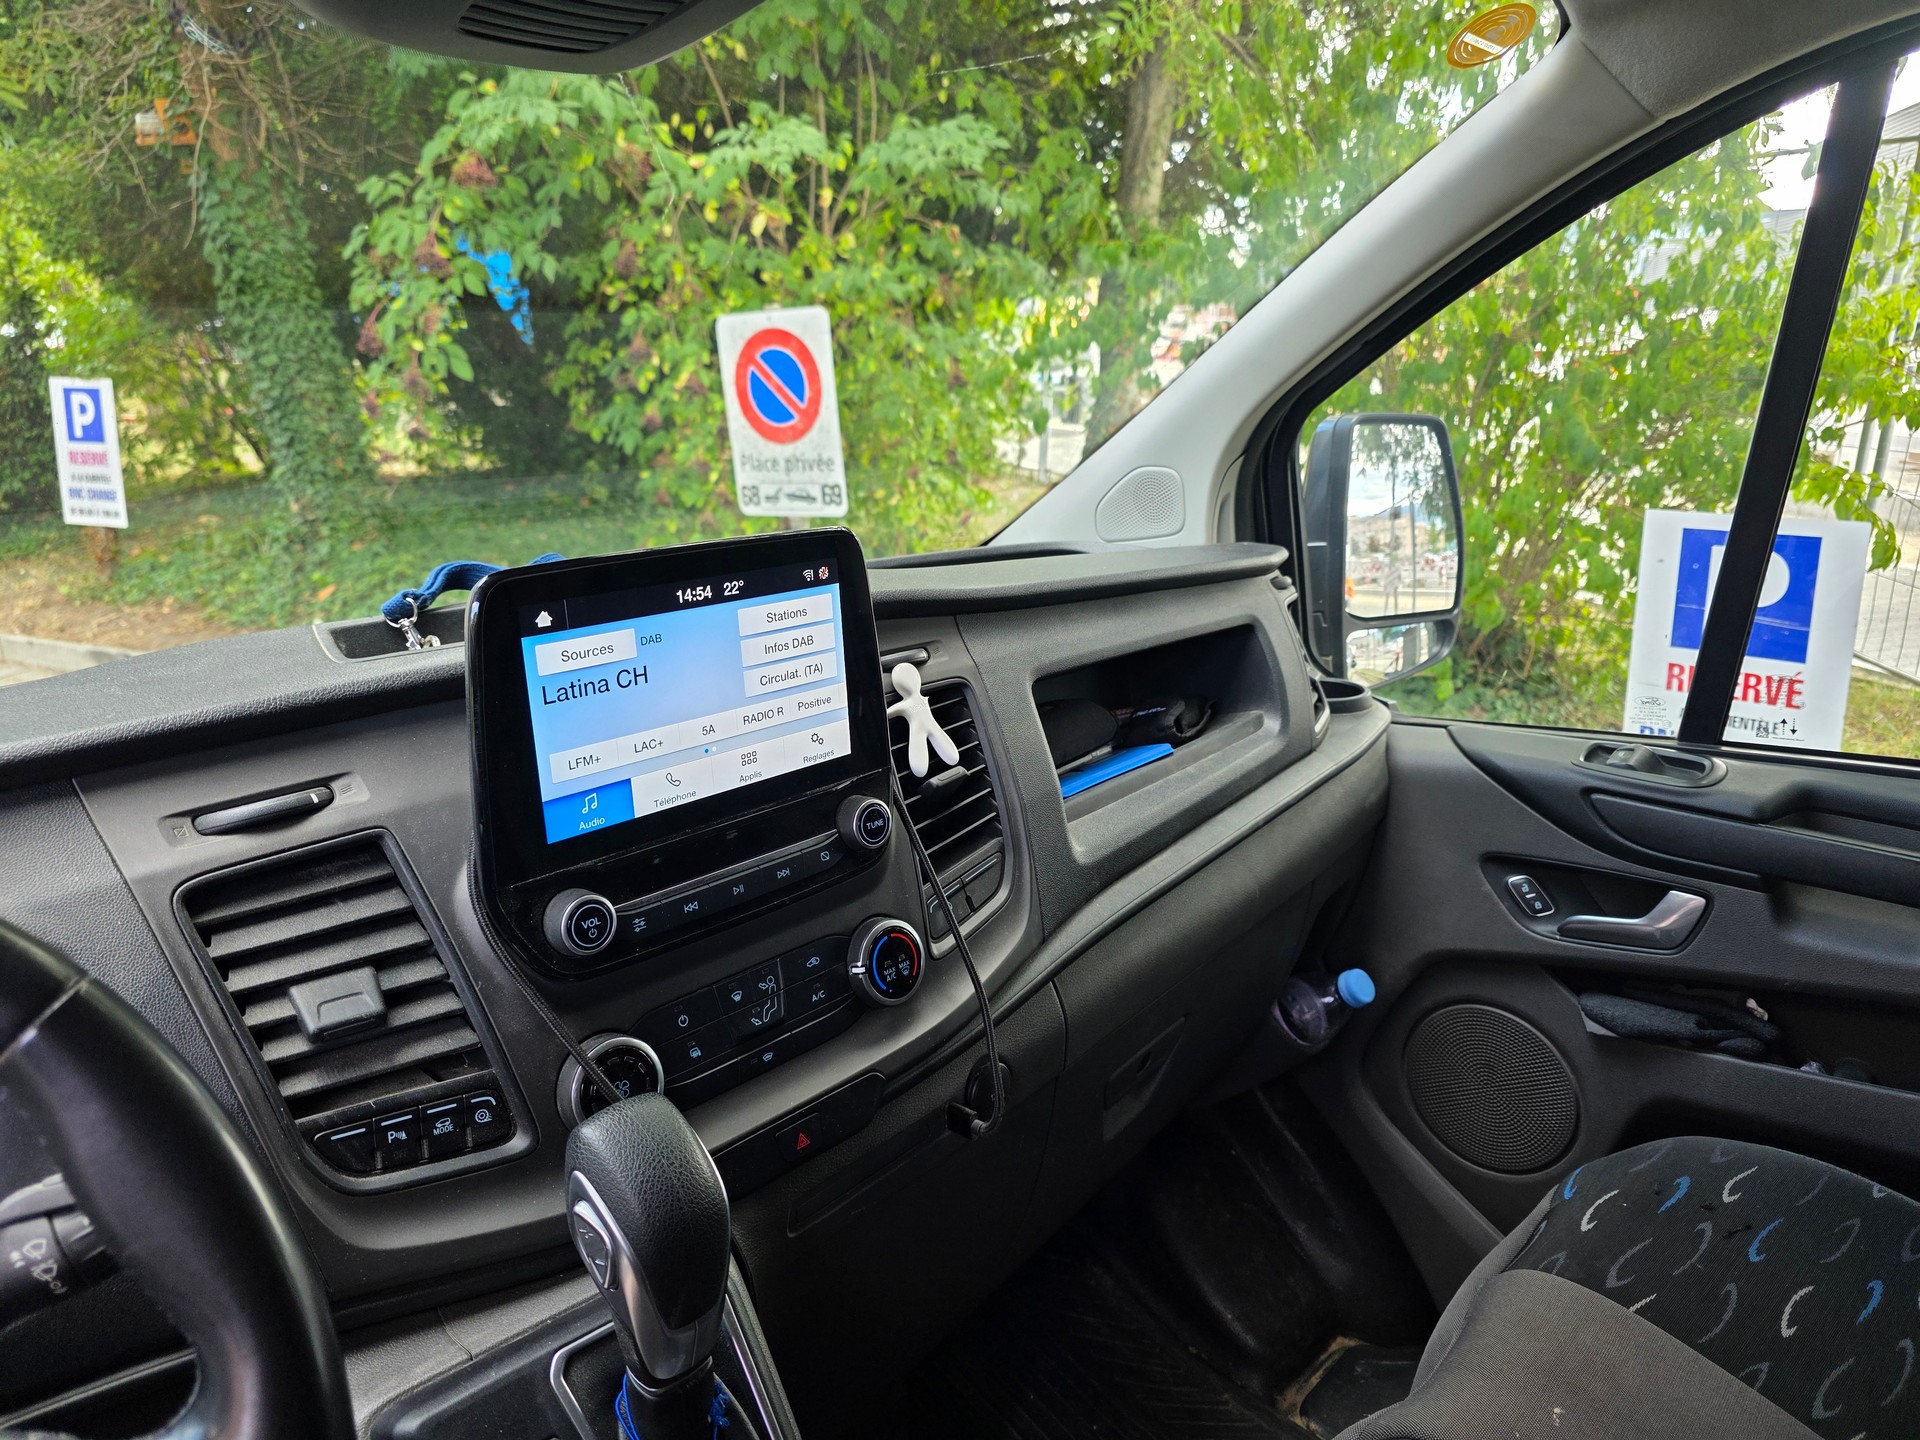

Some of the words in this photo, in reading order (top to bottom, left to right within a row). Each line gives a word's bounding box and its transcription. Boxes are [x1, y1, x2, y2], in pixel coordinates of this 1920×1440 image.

[69, 391, 96, 438] P
[676, 585, 712, 603] 14:54
[723, 580, 744, 596] 22°
[766, 607, 808, 624] Stations
[640, 633, 663, 646] DAB
[764, 639, 790, 655] Infos
[792, 635, 814, 650] DAB
[561, 644, 614, 663] Sources
[759, 667, 802, 686] Circulat.
[804, 662, 824, 680] (TA)
[542, 678, 611, 705] Latina
[616, 665, 649, 689] CH
[797, 696, 832, 712] Positive
[742, 709, 775, 726] RADIO
[776, 706, 785, 718] R
[701, 724, 716, 736] 5A
[633, 738, 664, 754] LAC+
[568, 754, 602, 771] LFM+
[802, 748, 835, 765] Réglages
[739, 771, 763, 784] Applis
[653, 790, 697, 808] Téléphone
[578, 816, 606, 831] Audio
[865, 818, 885, 830] TUNE
[581, 917, 602, 929] VOL
[811, 990, 826, 1003] A/C
[433, 1123, 454, 1136] MODE
